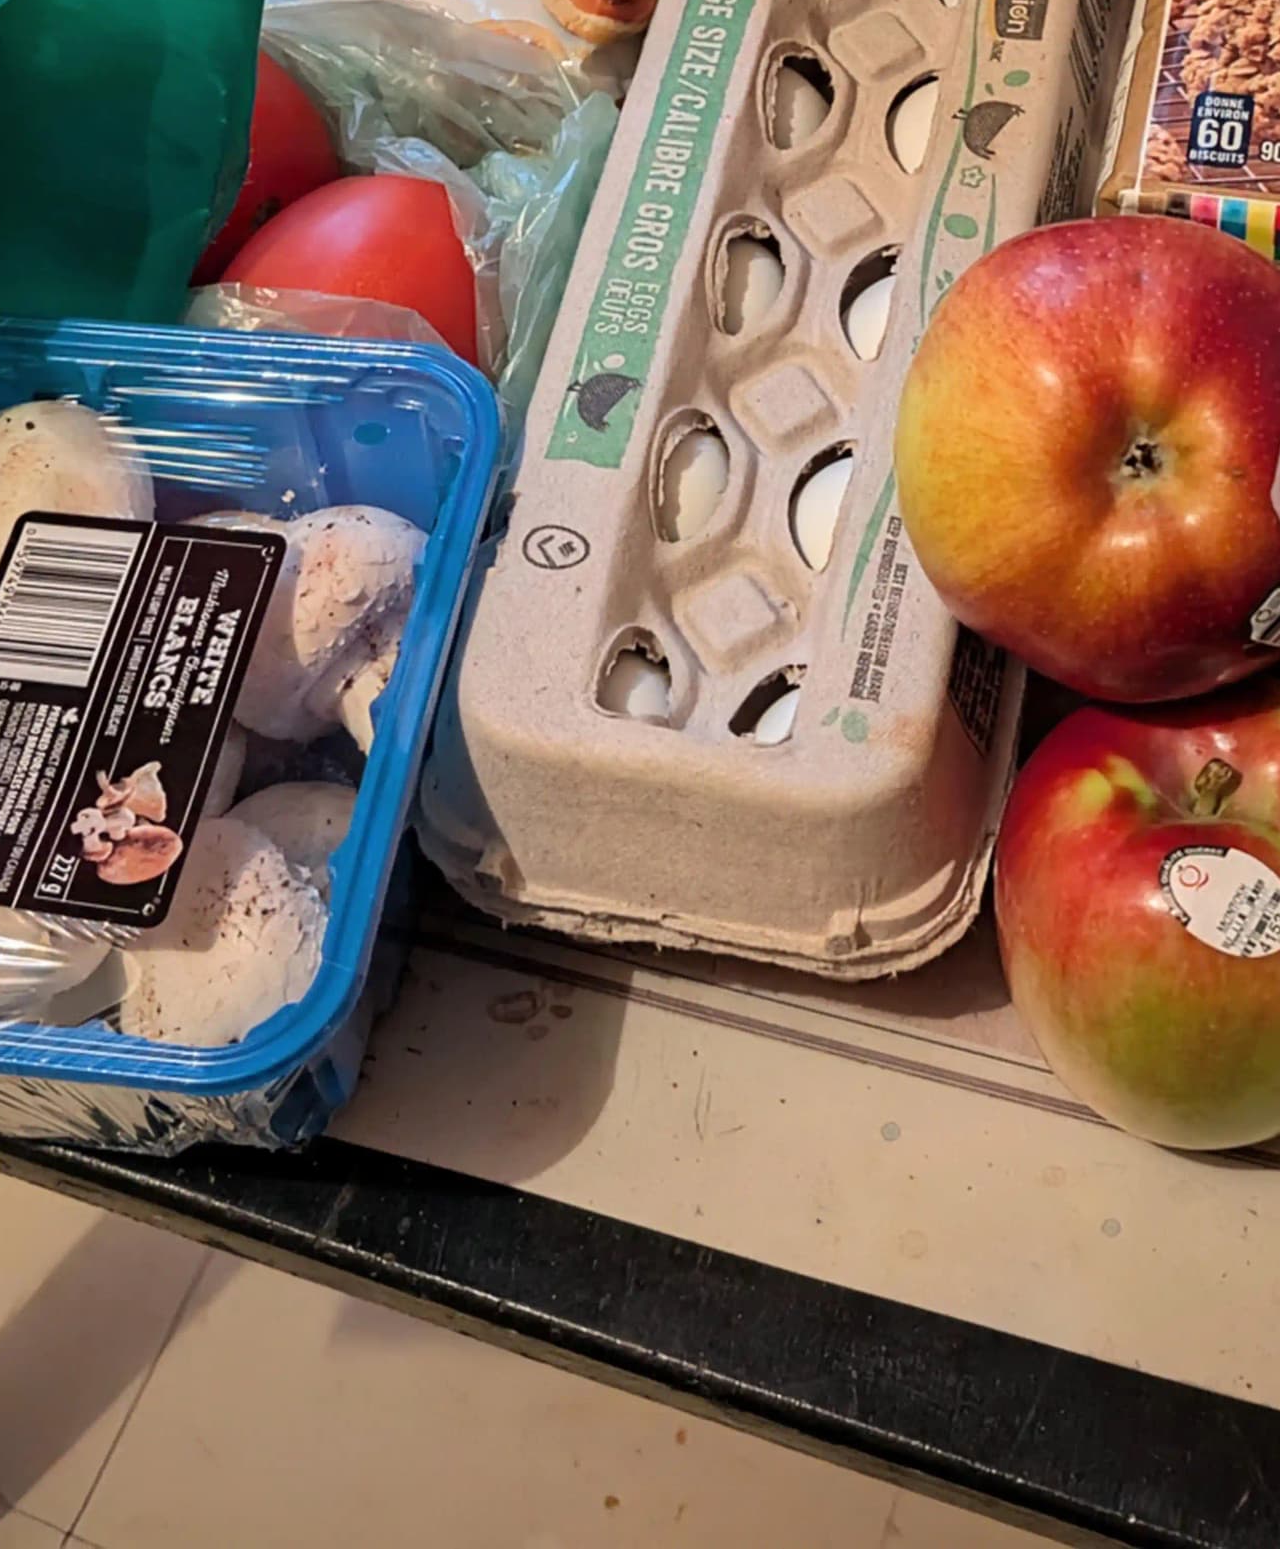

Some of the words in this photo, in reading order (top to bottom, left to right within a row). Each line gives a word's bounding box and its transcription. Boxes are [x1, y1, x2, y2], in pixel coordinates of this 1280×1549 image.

[643, 24, 727, 196] SIZE/CALIBRE
[1197, 106, 1250, 121] ENVIRON
[1204, 96, 1245, 109] DONNE
[1189, 149, 1245, 165] BISCUITS
[1197, 119, 1244, 151] 60
[622, 202, 675, 272] GROS
[622, 280, 662, 334] EGGS
[190, 566, 231, 652] Mushrooms
[141, 592, 199, 713] BLANCS
[190, 604, 243, 710] WHITE
[158, 653, 201, 748] Champignons
[48, 852, 76, 884] 227
